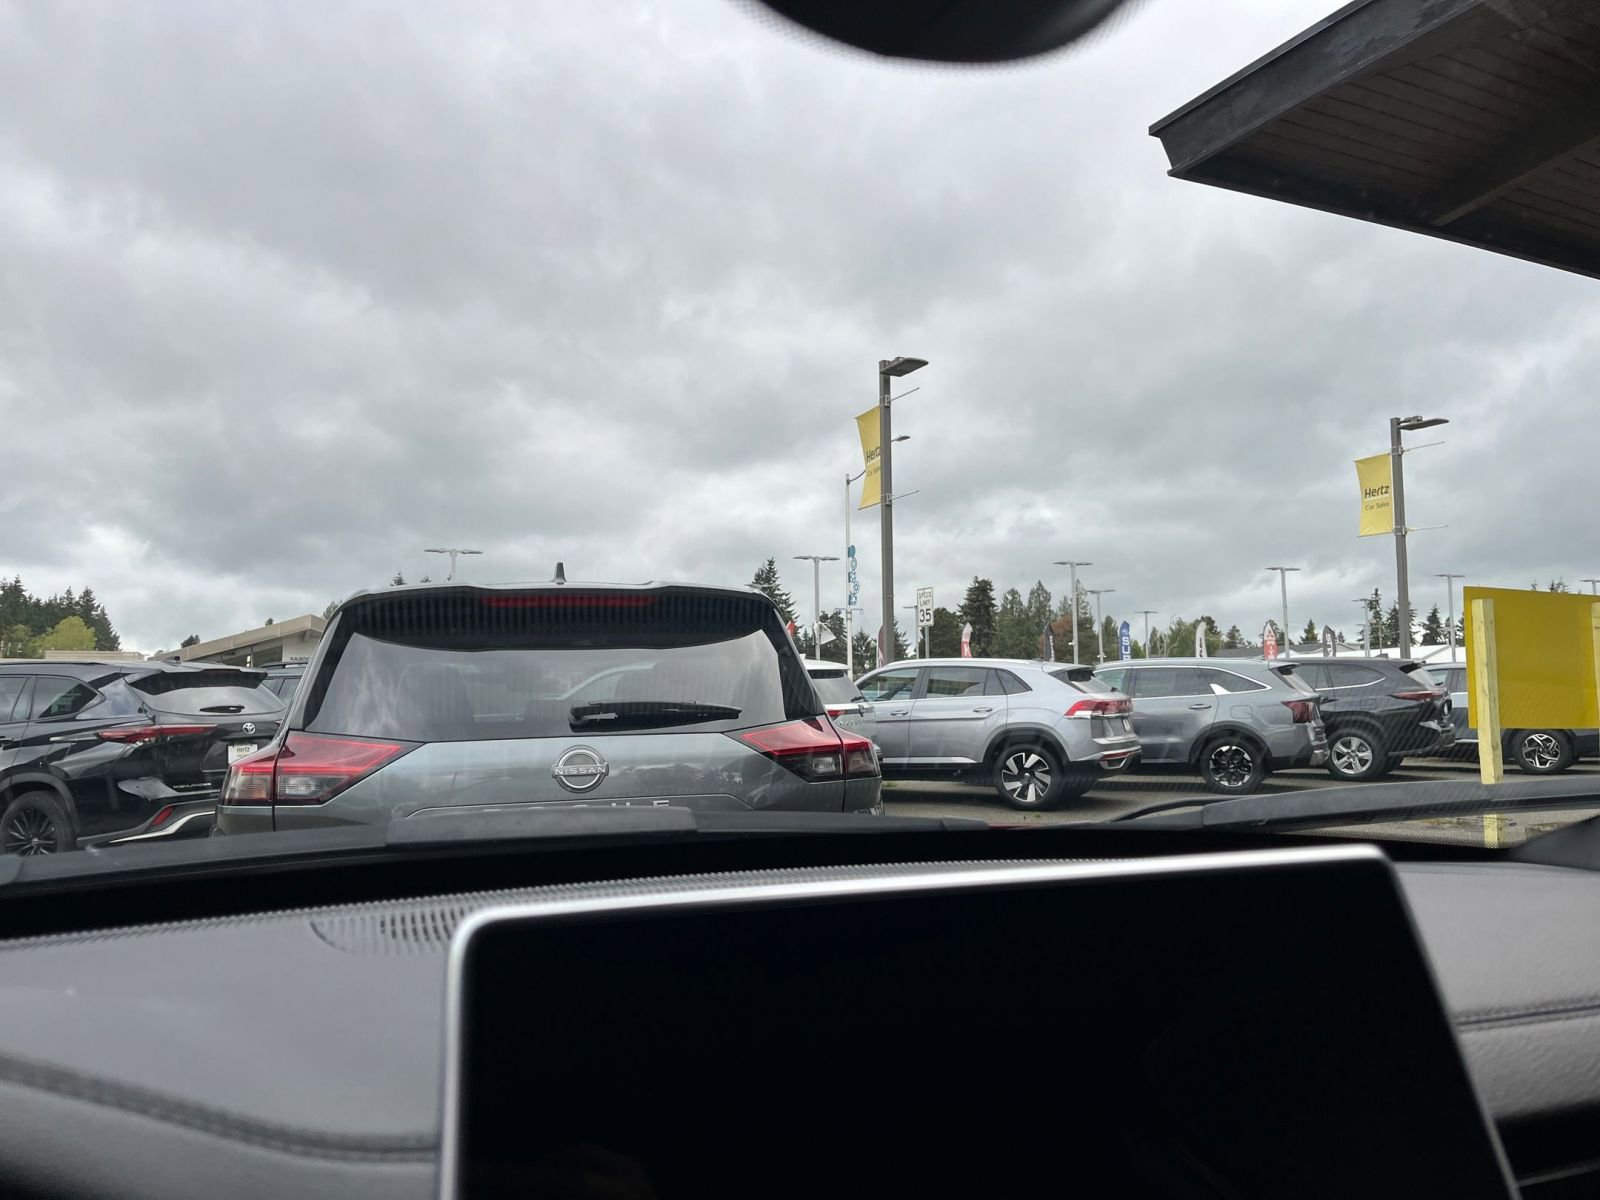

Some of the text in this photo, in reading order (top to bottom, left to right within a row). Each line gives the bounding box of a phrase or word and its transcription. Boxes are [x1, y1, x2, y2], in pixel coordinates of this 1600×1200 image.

[1364, 485, 1390, 499] Hertz
[919, 608, 932, 623] 35
[555, 766, 606, 775] NISSAN
